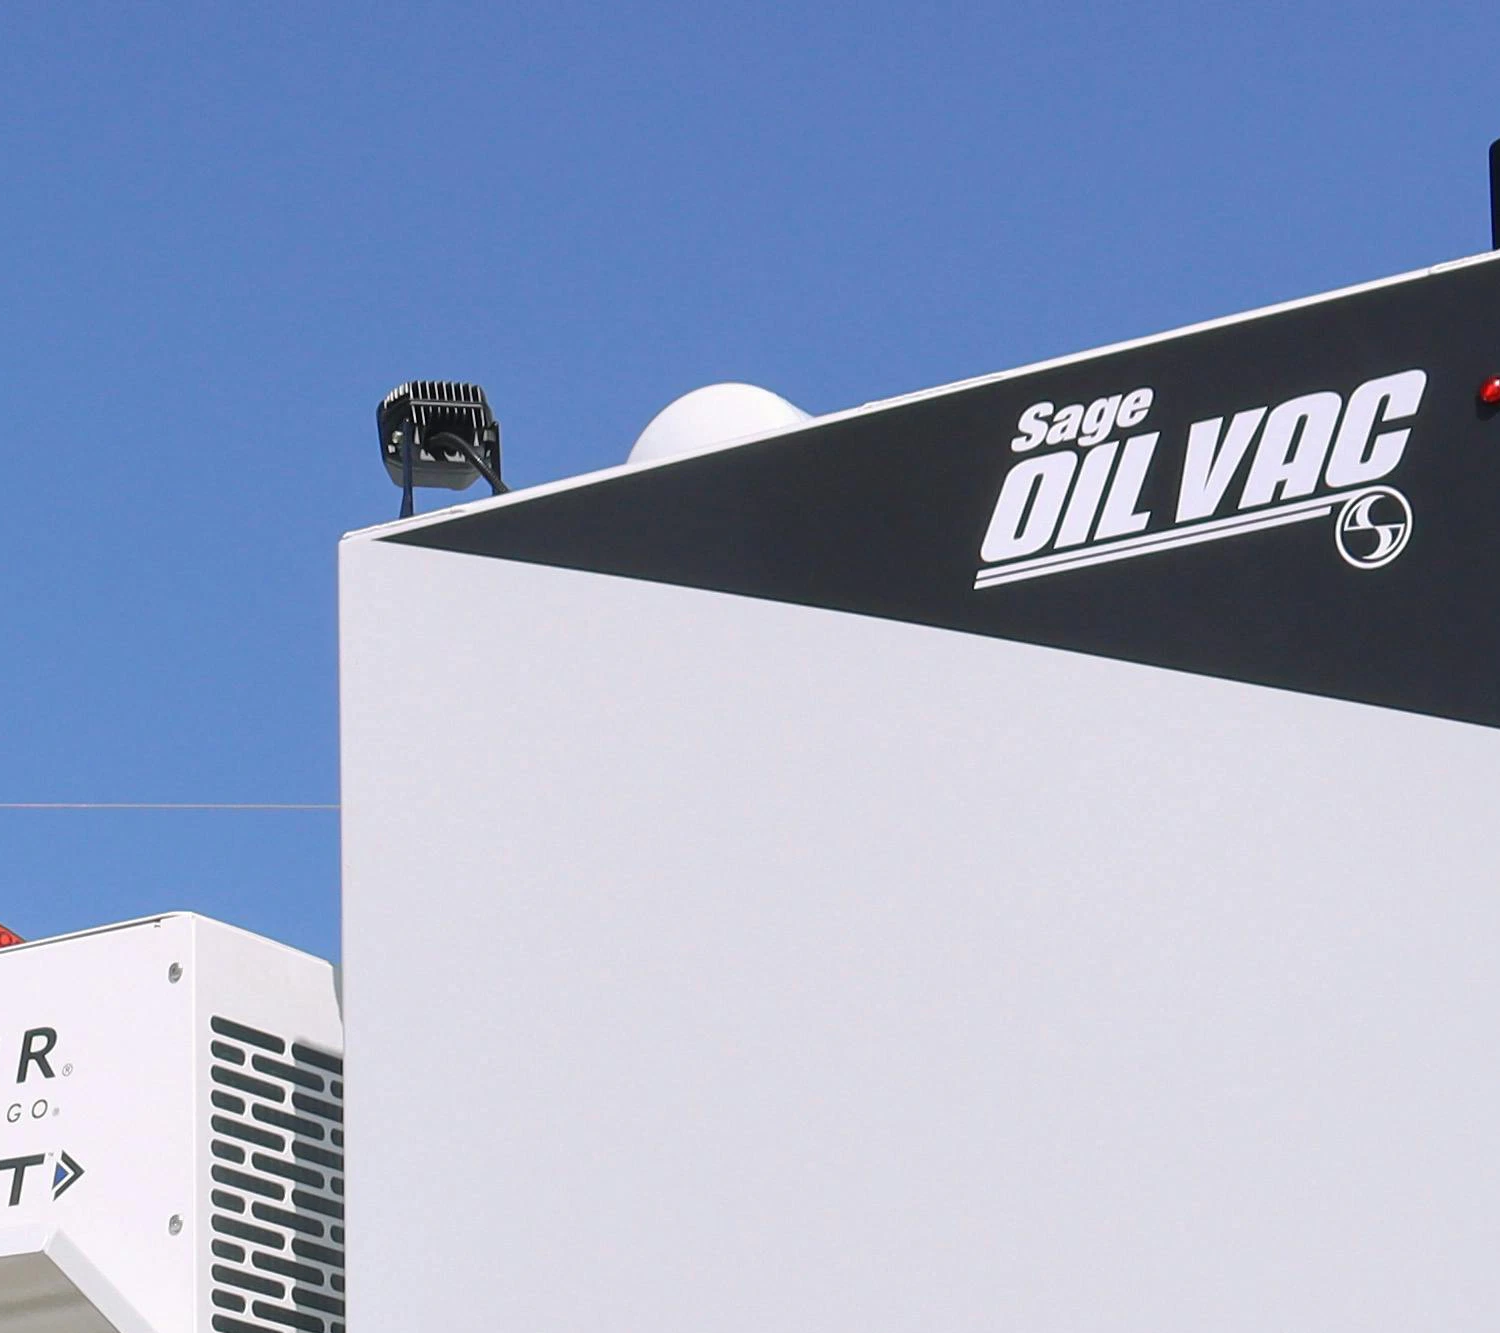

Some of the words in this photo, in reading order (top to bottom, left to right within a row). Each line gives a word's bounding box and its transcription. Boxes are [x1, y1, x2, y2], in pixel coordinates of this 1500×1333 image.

[1011, 386, 1154, 453] Sage
[980, 431, 1161, 562] OIL
[1175, 368, 1427, 523] VAC
[6, 1099, 49, 1123] GO
